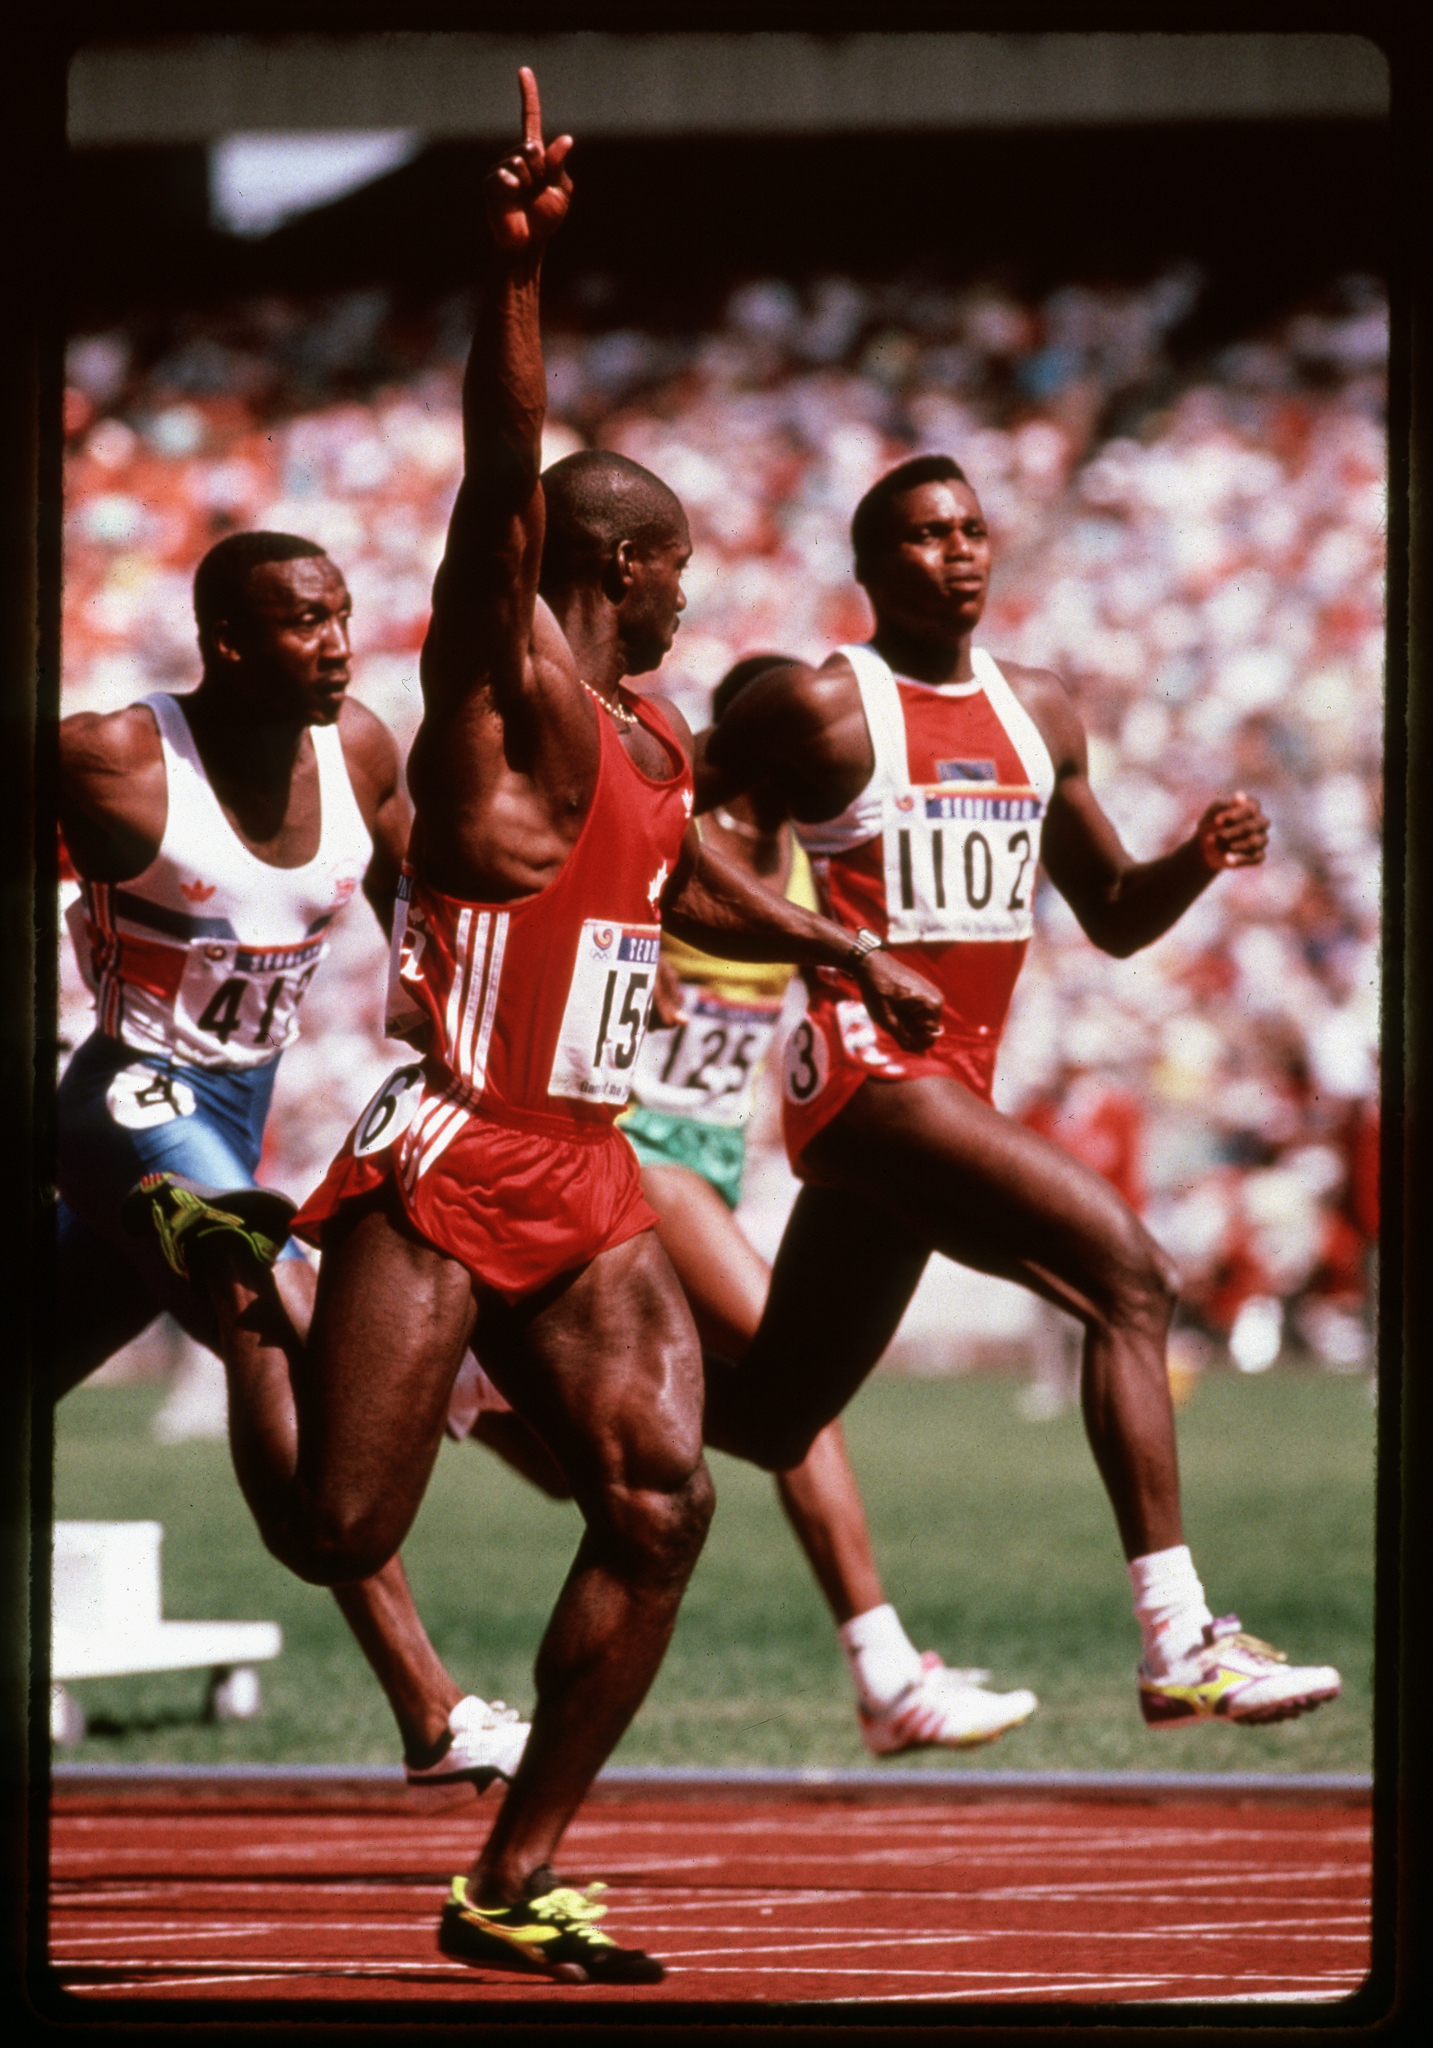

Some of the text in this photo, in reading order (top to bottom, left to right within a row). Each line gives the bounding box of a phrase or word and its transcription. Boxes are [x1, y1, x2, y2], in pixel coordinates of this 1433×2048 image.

[898, 829, 1031, 910] 1102
[629, 938, 660, 962] SEOU
[593, 970, 652, 1070] 15
[659, 1026, 756, 1093] 125
[790, 1019, 818, 1100] 3
[134, 1073, 183, 1116] 4
[360, 1067, 421, 1150] 6
